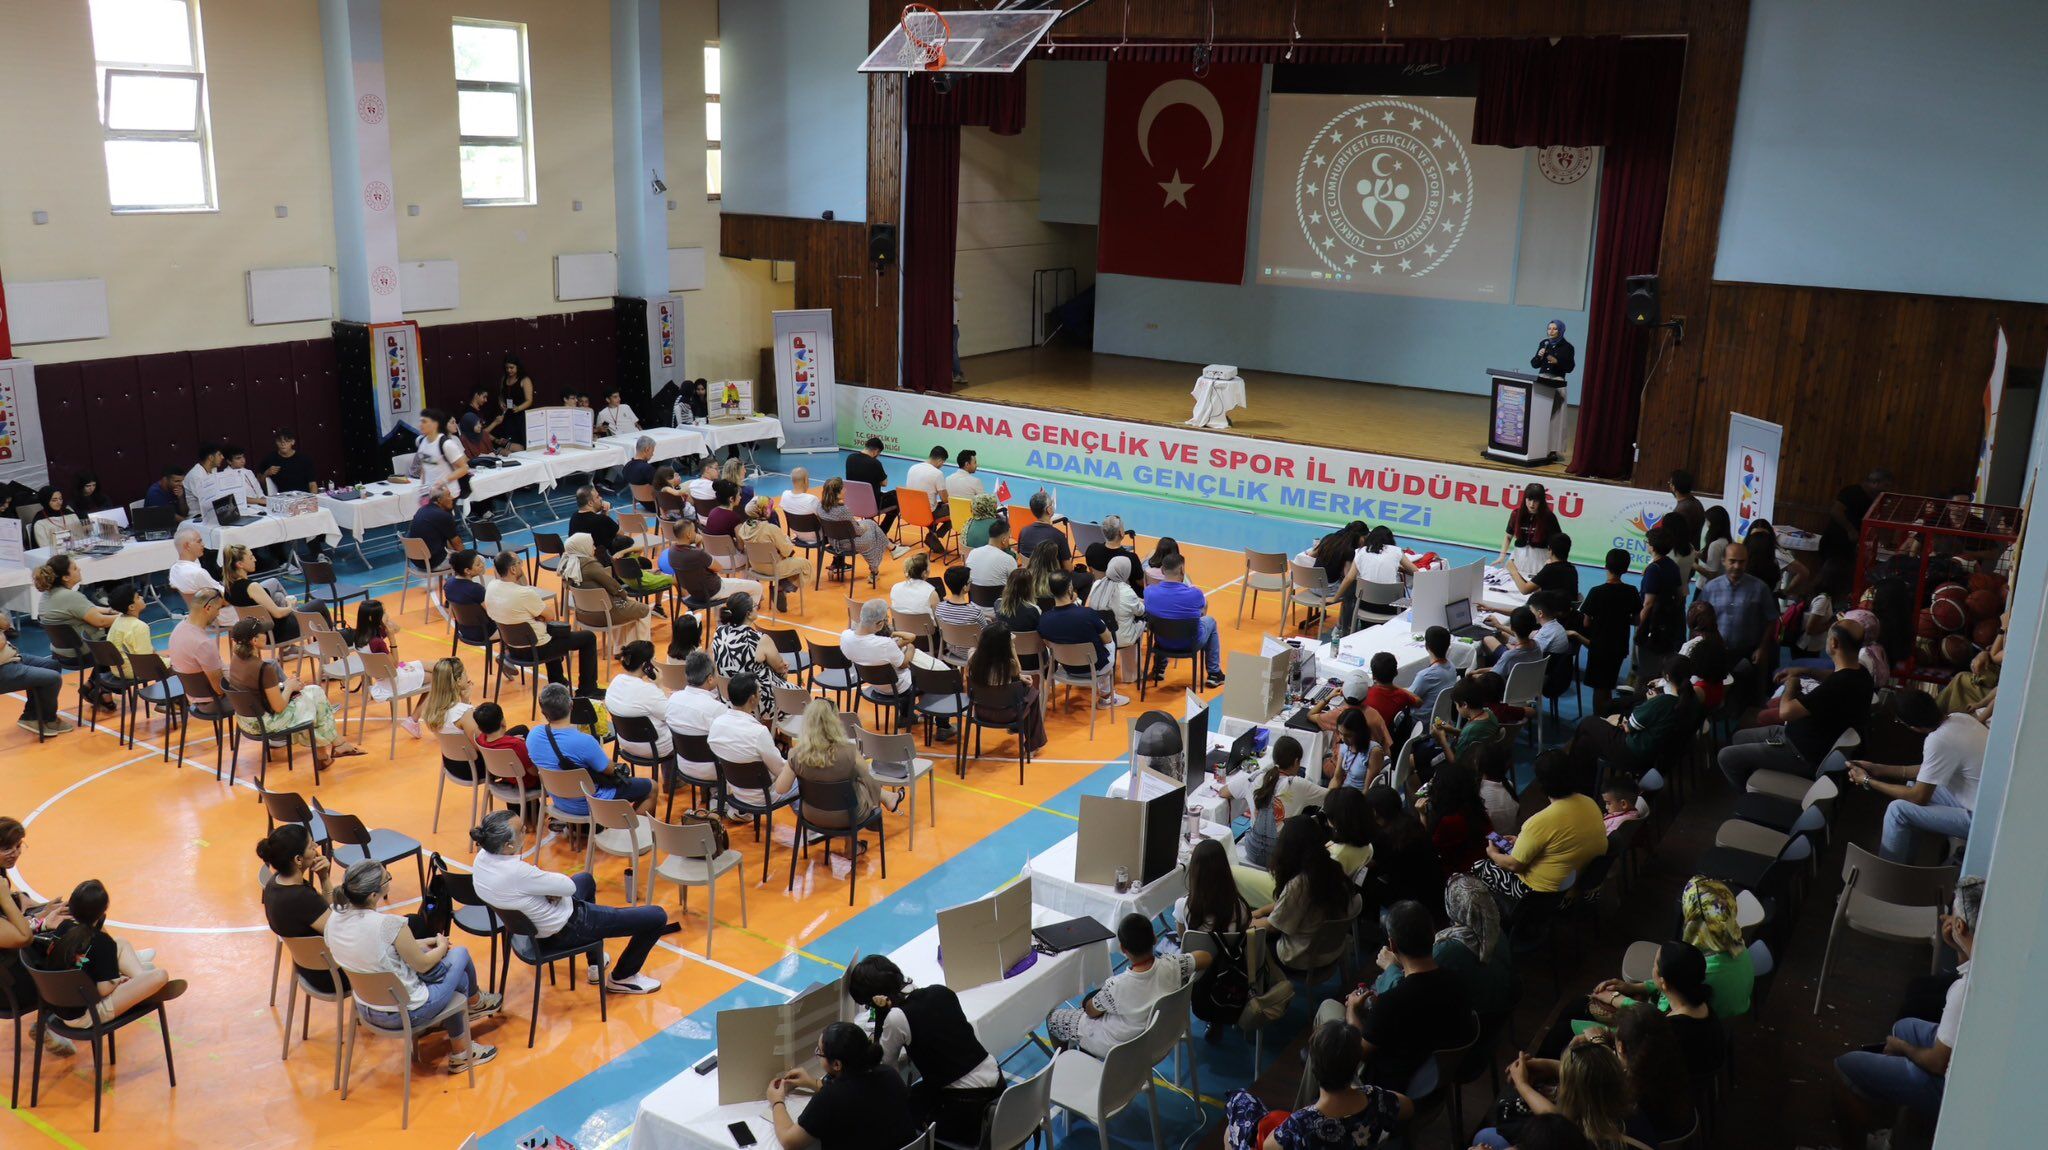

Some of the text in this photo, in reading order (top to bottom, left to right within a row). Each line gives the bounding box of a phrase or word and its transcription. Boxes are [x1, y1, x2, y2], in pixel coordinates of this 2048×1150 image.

[1327, 136, 1369, 207] CUMHURİYETİ
[1370, 134, 1419, 154] GENÇLİK
[1417, 149, 1431, 166] VE
[1426, 166, 1440, 198] SPOR
[1393, 200, 1439, 250] BAKANLIĞI
[661, 305, 673, 365] DENEYAP
[387, 335, 402, 410] DENEYAP
[793, 336, 811, 418] DENEYAP
[922, 409, 1014, 438] ADANA
[1021, 421, 1149, 458] GENÇLİK
[1159, 440, 1199, 465] VE
[1208, 448, 1295, 478] SPOR
[1306, 456, 1336, 484] İL
[1025, 449, 1124, 481] ADANA
